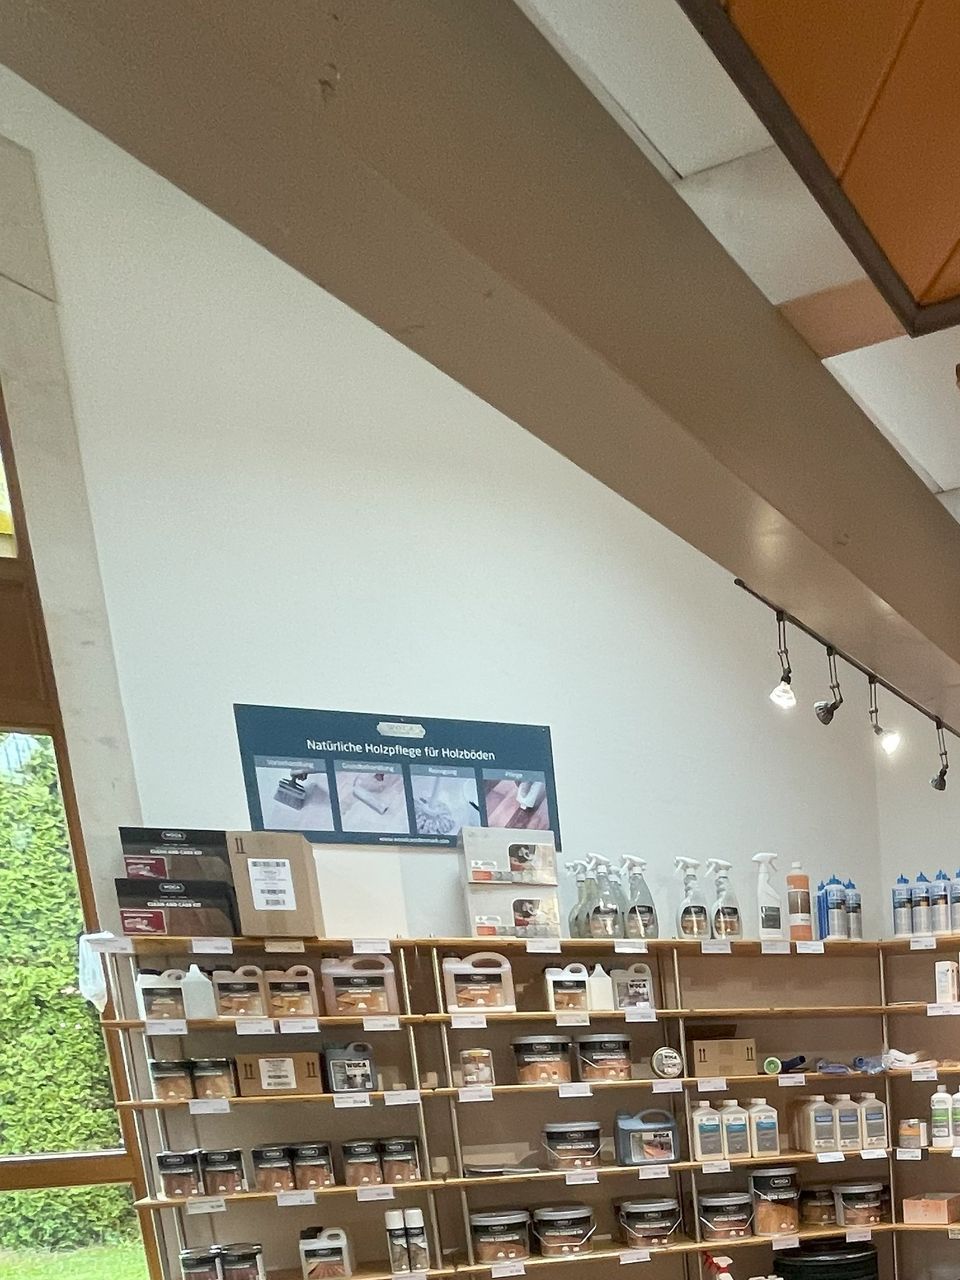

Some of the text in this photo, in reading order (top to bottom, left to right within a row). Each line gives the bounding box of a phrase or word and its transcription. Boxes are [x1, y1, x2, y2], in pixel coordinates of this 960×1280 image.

[306, 739, 496, 761] Natürliche Holzpflege für Holzböden
